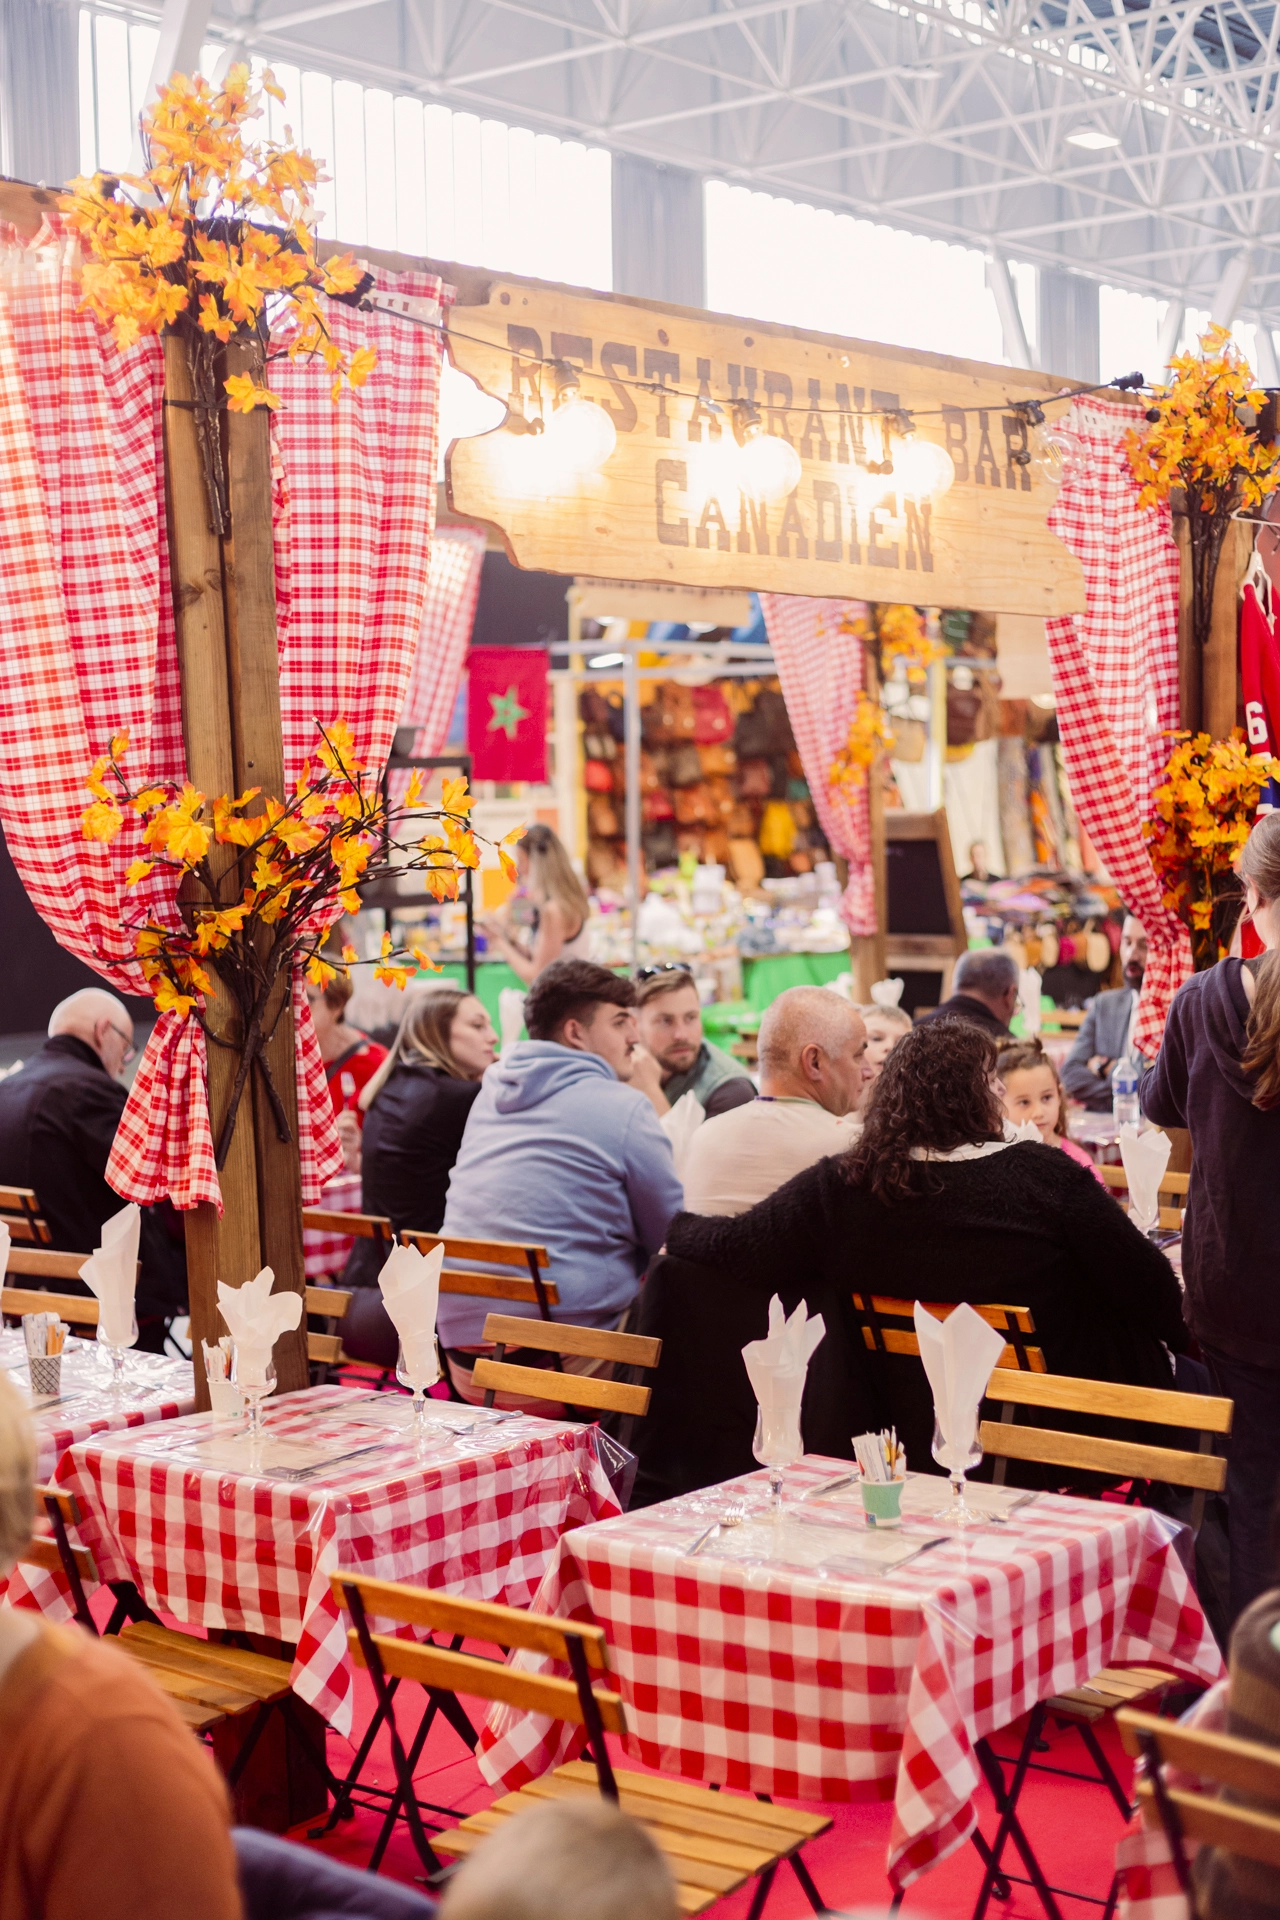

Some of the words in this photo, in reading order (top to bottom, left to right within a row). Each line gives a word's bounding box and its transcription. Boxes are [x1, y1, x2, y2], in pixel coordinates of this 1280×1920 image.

[941, 402, 1032, 492] BAR
[655, 458, 934, 573] CANADIEN
[1245, 700, 1269, 746] 6
